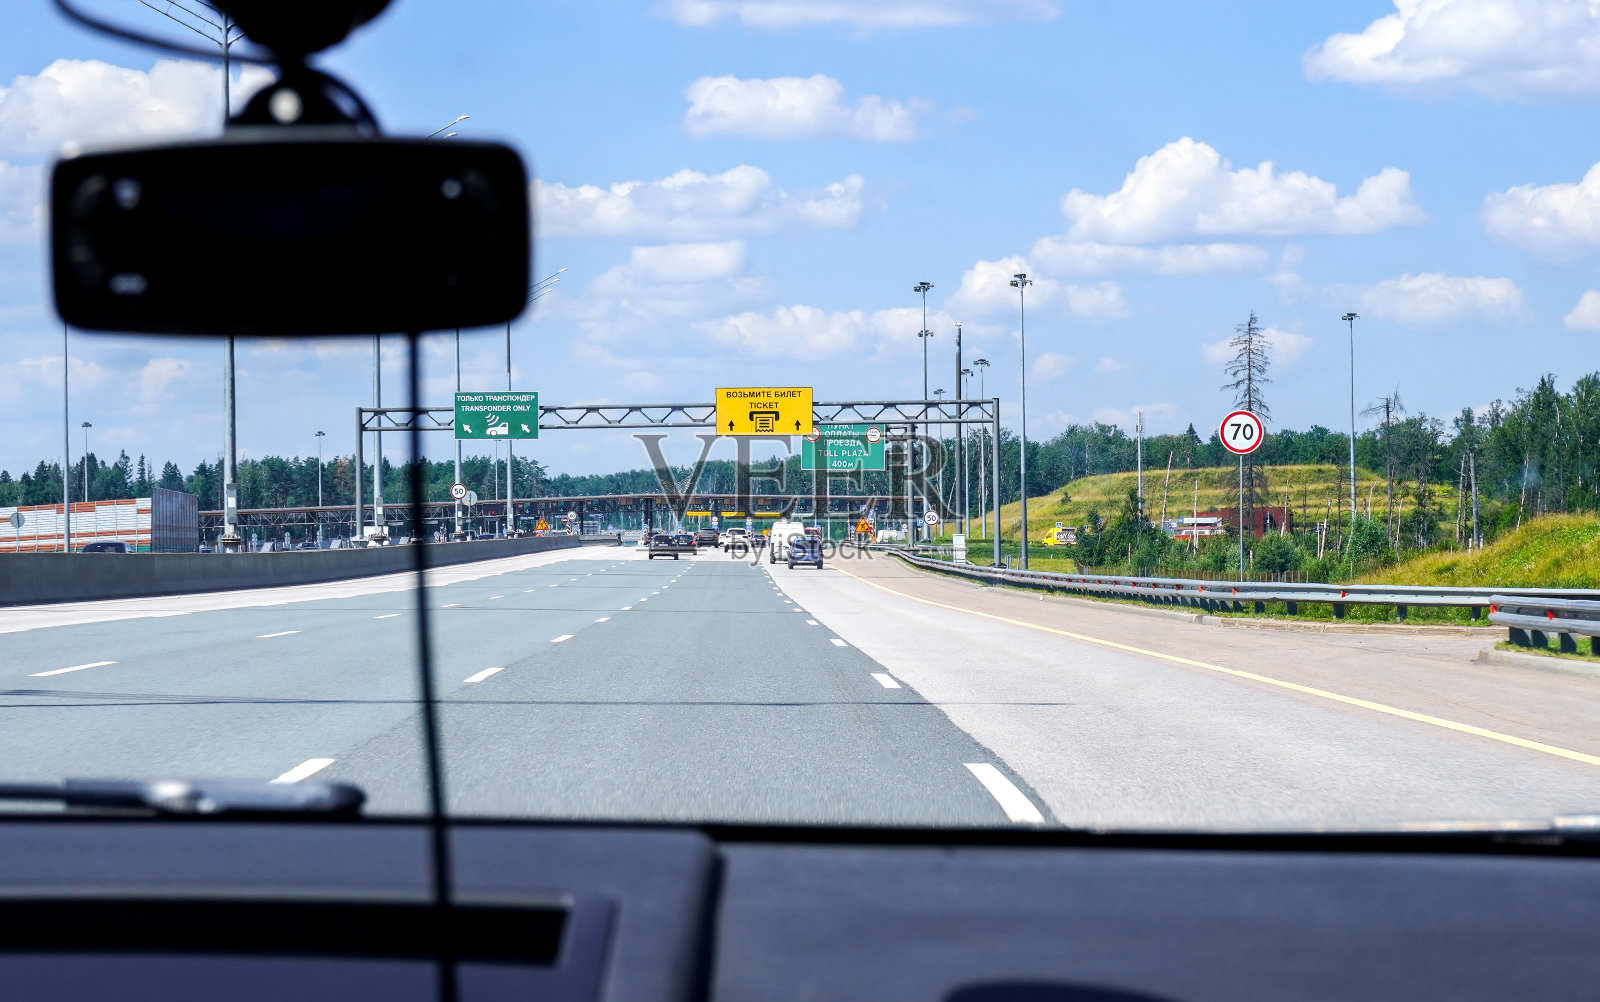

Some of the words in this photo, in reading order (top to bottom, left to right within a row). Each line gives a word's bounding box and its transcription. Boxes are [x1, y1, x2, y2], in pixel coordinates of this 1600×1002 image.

[824, 430, 860, 438] ОПЛАТЫ
[1230, 423, 1254, 441] 70
[823, 439, 863, 447] ПРОЕЗДА
[818, 449, 838, 457] TOLL
[841, 449, 869, 457] PLAZA
[926, 514, 937, 522] 50
